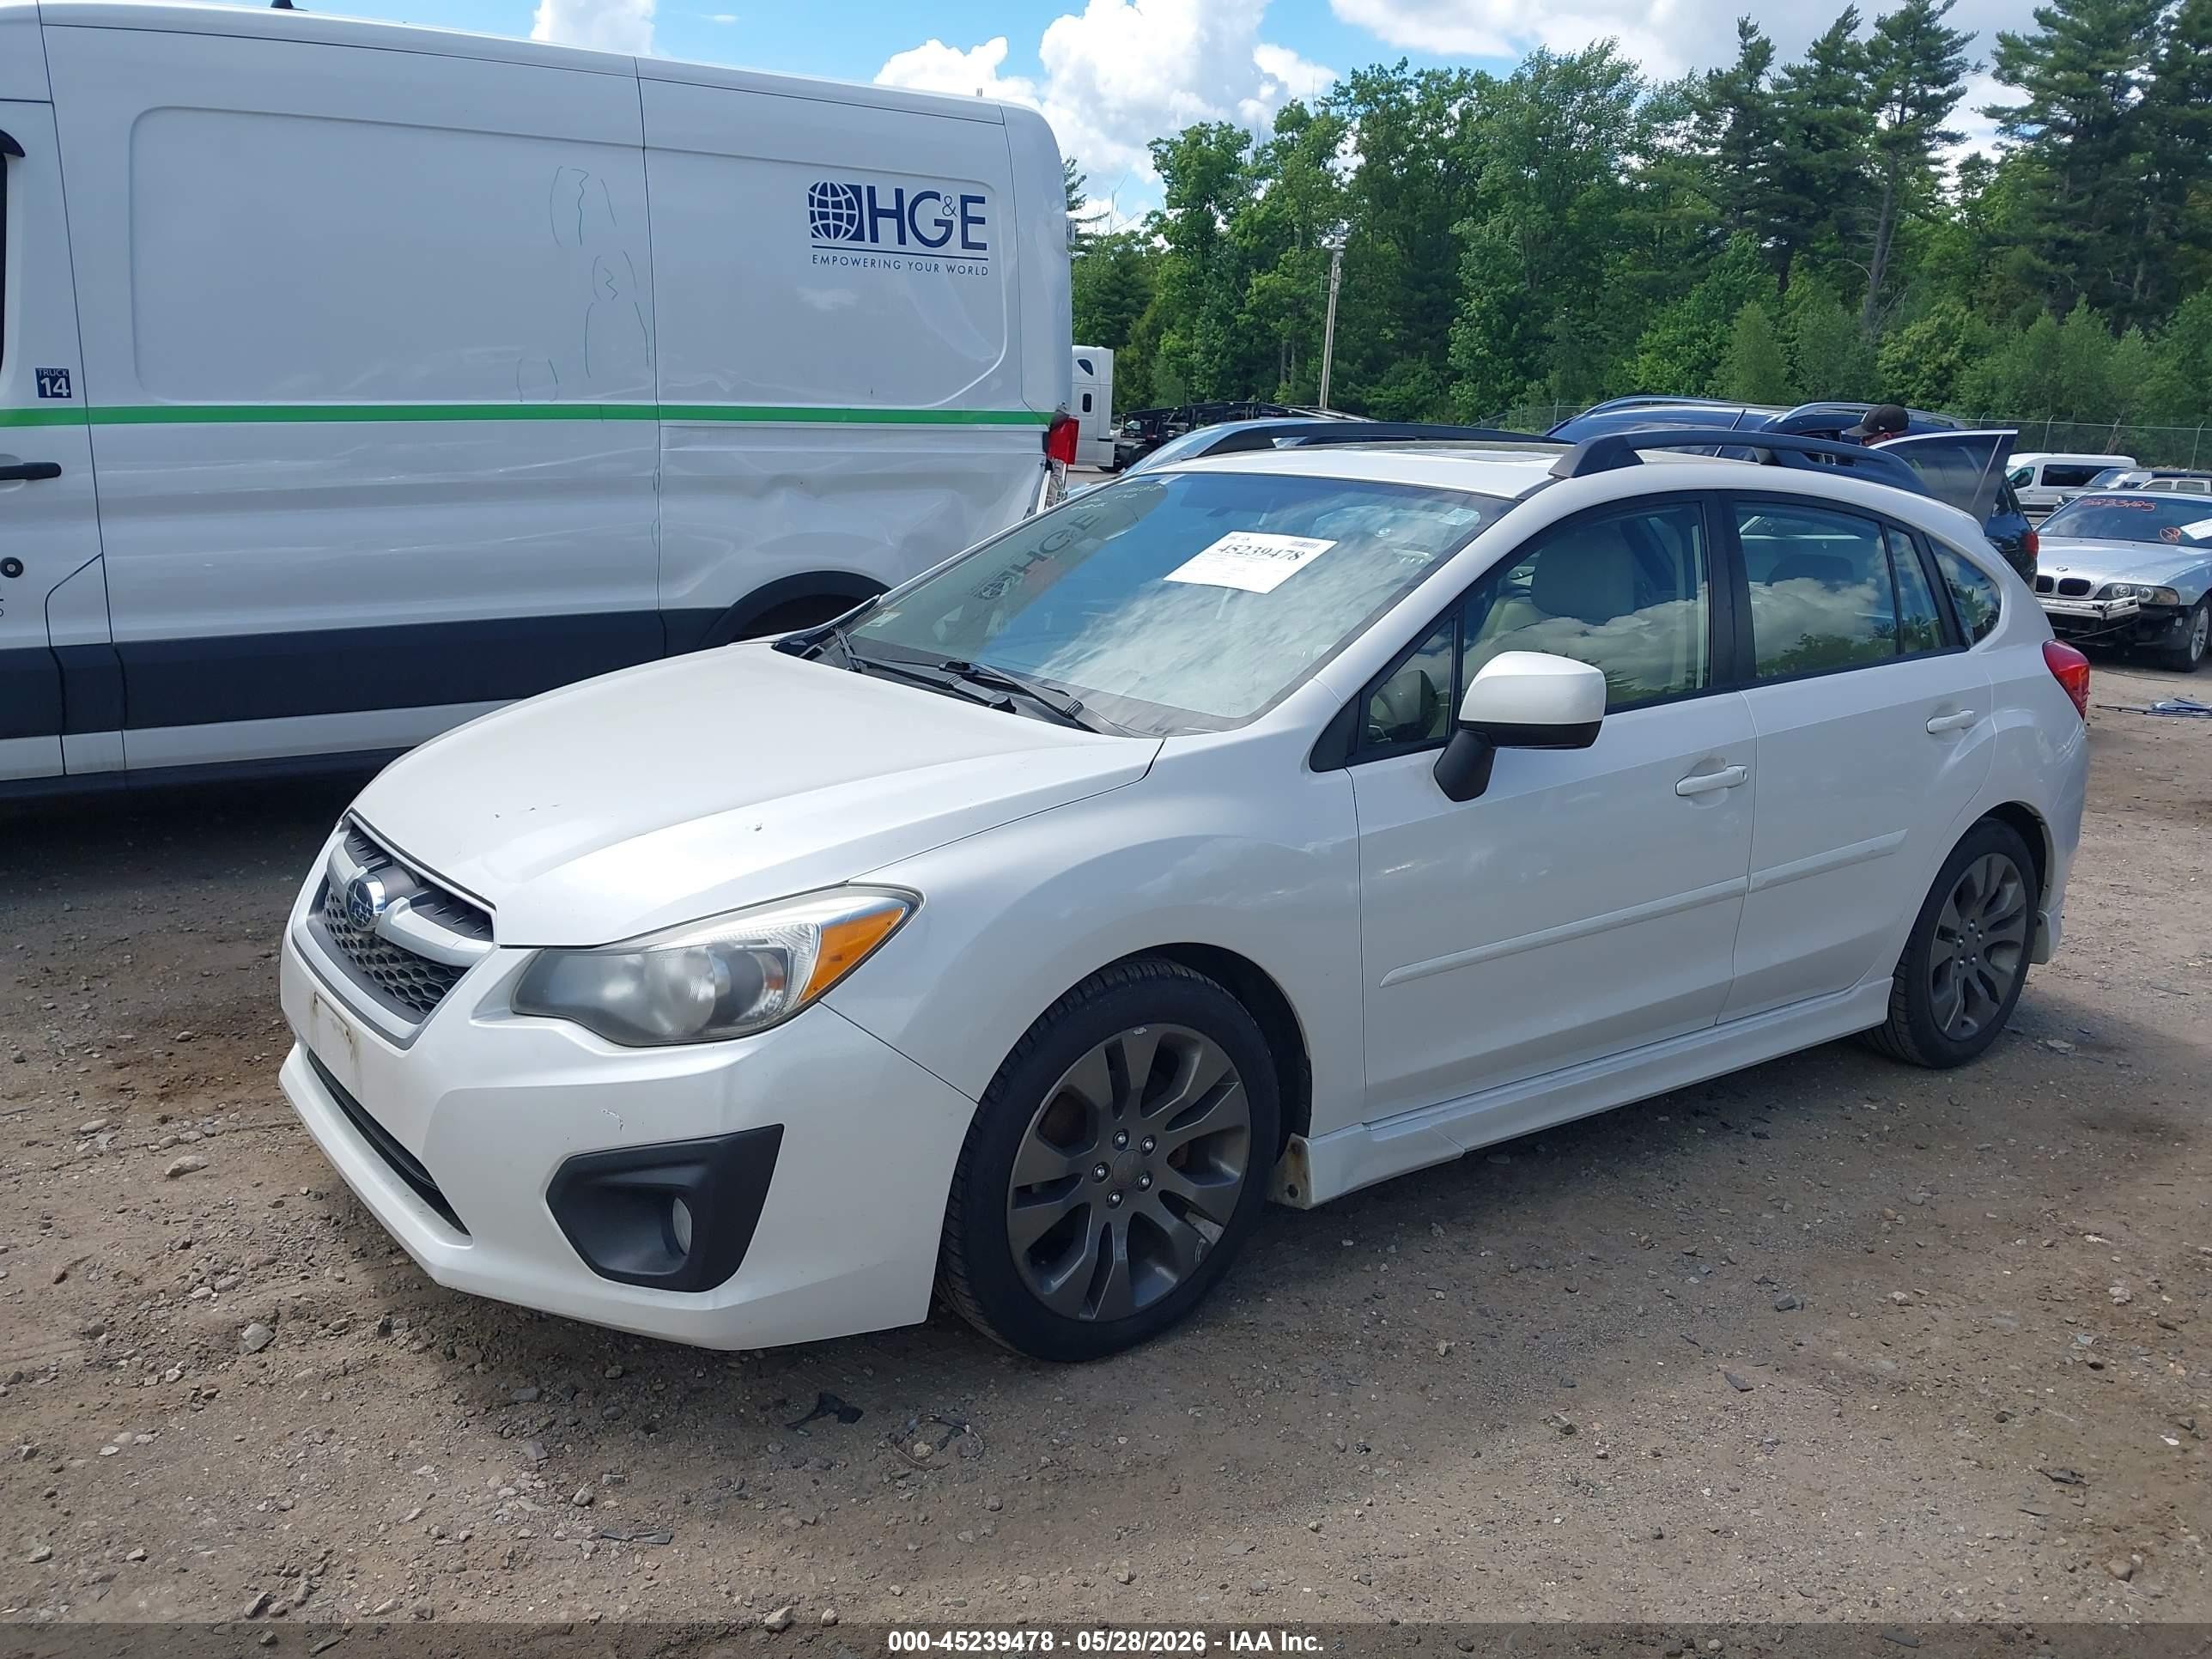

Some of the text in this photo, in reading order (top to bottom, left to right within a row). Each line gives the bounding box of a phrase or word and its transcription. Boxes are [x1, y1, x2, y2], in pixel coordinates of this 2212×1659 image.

[866, 185, 988, 251] HG&E
[812, 254, 988, 276] EMPOWERING YOUR WORLD
[39, 368, 69, 377] TRUCK
[40, 377, 70, 397] 14
[1217, 543, 1306, 562] 45239478
